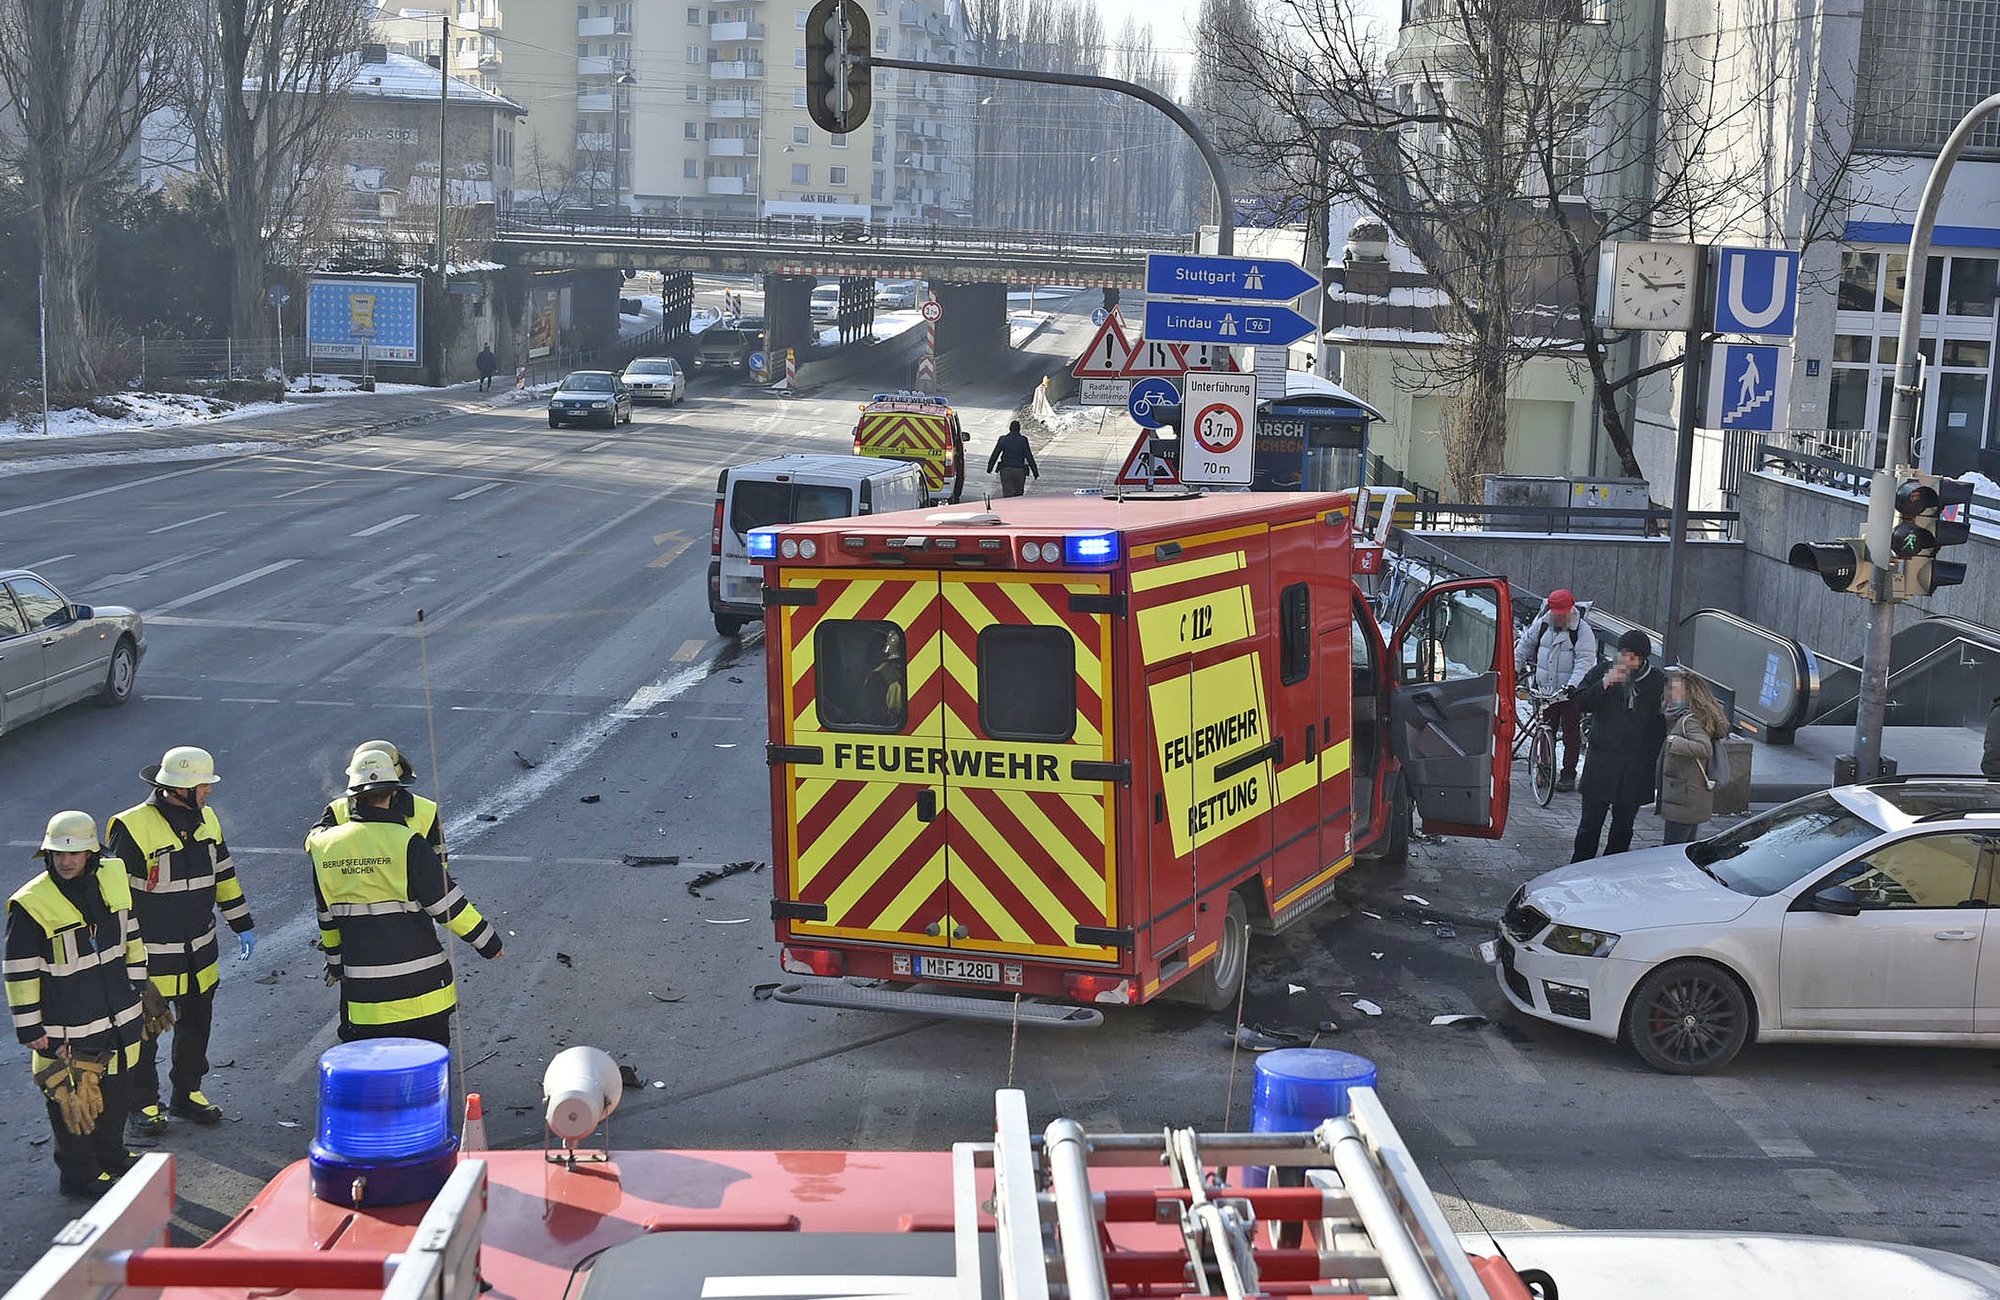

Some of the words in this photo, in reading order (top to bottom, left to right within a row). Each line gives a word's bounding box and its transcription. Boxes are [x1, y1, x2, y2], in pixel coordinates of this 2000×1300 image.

[1175, 267, 1236, 285] Stuttgart
[1728, 254, 1789, 328] U
[1167, 315, 1212, 329] Lindau
[1251, 320, 1264, 330] 96
[1089, 383, 1123, 391] Radfahrer
[1191, 380, 1250, 395] Unterführung
[1203, 462, 1217, 474] 70
[1219, 464, 1230, 474] m
[1191, 604, 1212, 641] 112
[1164, 708, 1258, 773] FEUERWEHR
[834, 743, 1060, 781] FEUERWEHR
[1188, 776, 1258, 838] RETTUNG
[323, 856, 391, 869] BERUFSFEUERWEHR
[341, 865, 375, 875] MÜNCHEN
[926, 958, 936, 974] M
[945, 960, 955, 975] F
[957, 962, 993, 979] 1280
